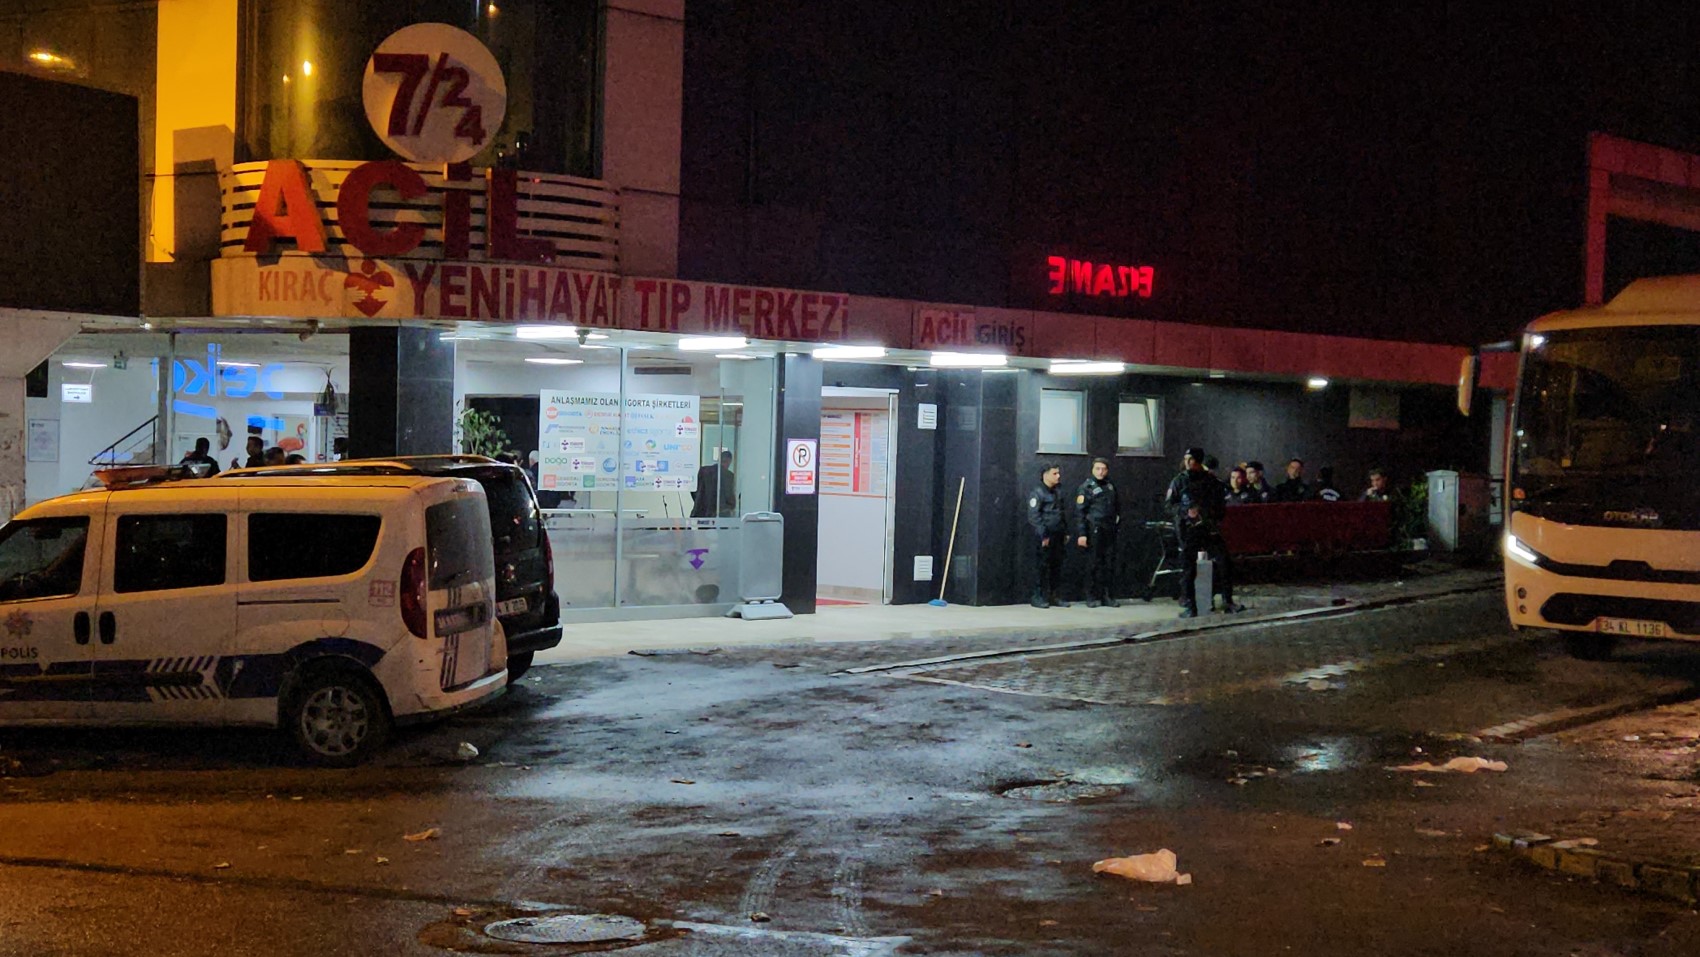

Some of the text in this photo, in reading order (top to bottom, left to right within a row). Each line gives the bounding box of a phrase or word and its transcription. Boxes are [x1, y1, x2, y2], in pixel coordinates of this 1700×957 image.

[373, 52, 486, 146] 7/24
[259, 270, 334, 305] KIRAÇ
[635, 280, 691, 330] TIP
[550, 396, 691, 410] ANLAŞMAMIZ OLAN İGORTA ŞİRKETLERİ
